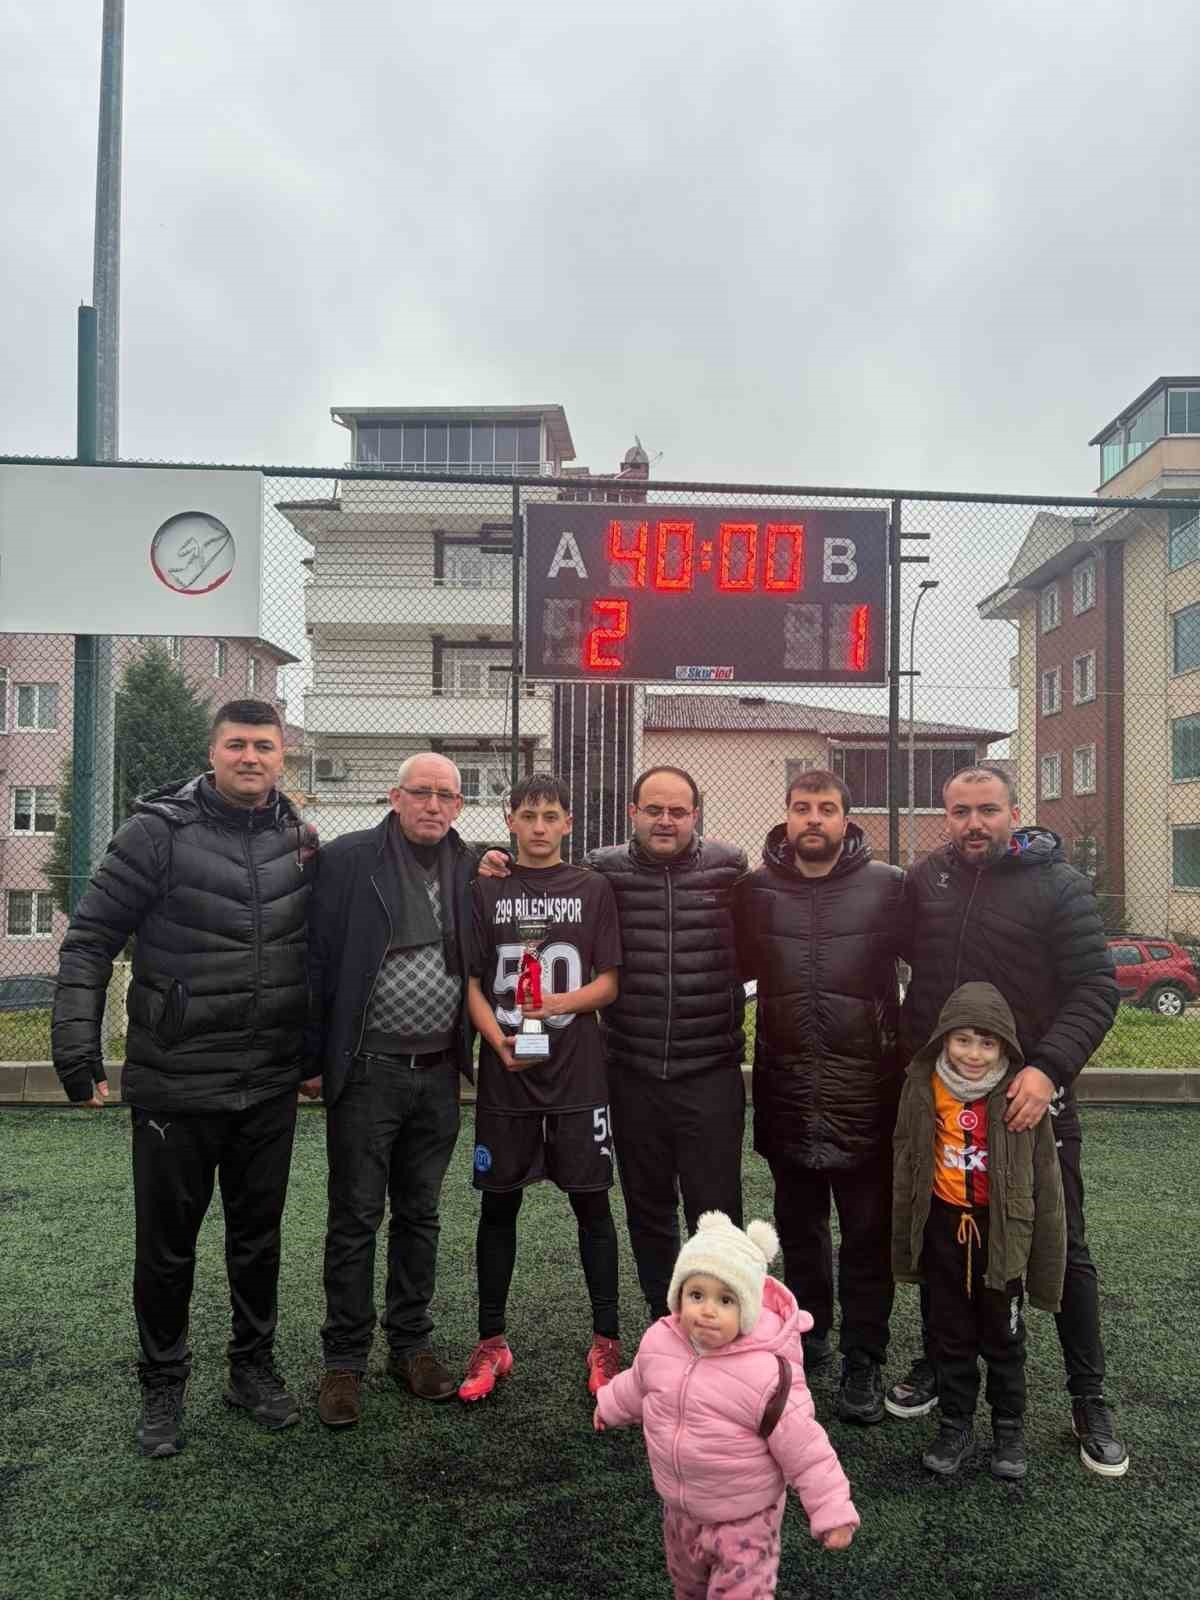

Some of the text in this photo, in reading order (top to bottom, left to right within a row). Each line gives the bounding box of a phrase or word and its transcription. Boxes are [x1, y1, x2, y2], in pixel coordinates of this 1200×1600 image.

[547, 519, 859, 591] A 40:00 B
[587, 599, 630, 669] 2
[853, 603, 870, 672] 1
[493, 941, 583, 1029] 50
